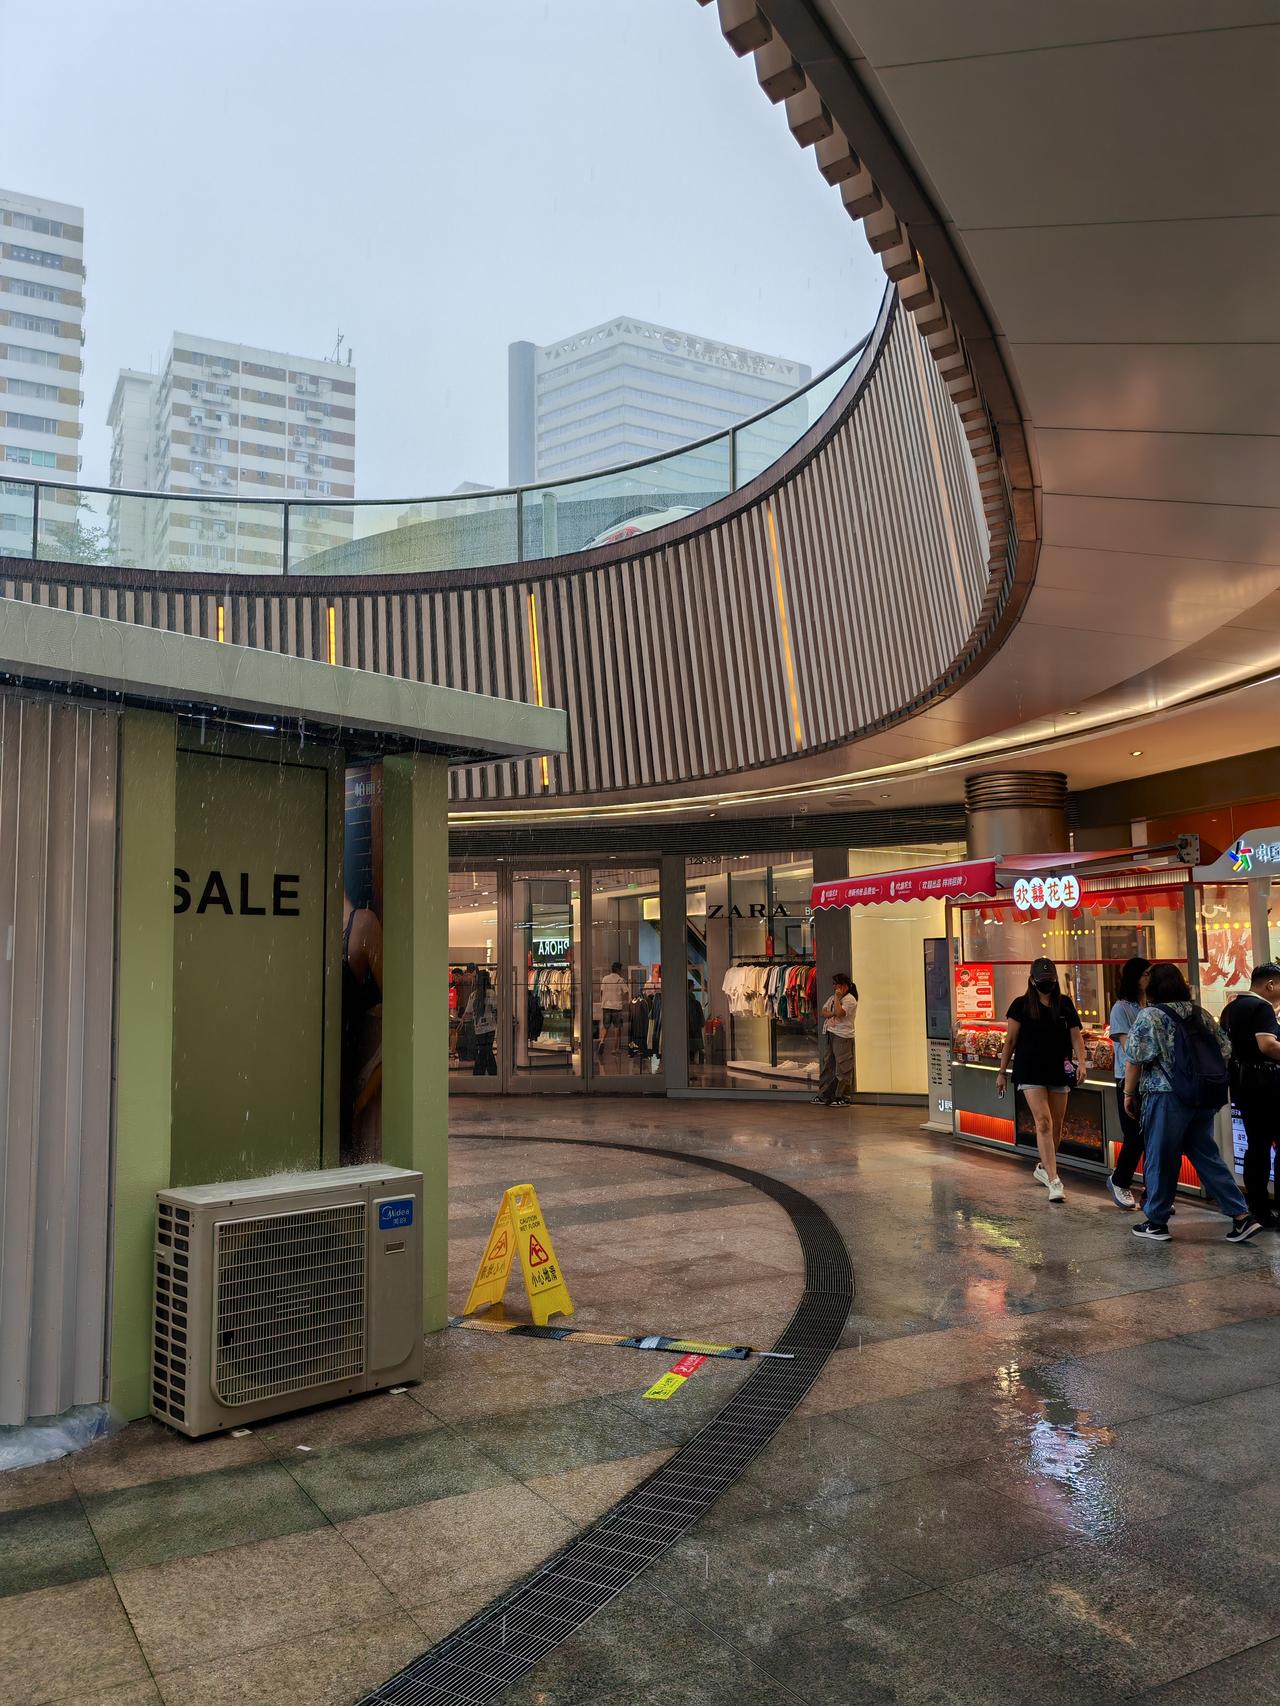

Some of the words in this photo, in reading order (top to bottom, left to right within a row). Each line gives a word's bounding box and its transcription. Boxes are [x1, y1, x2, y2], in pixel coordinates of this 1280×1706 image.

[174, 867, 301, 917] SALE
[708, 903, 790, 919] ZARA
[387, 1208, 410, 1219] Midea
[519, 1215, 538, 1226] CAUTION
[519, 1225, 528, 1233] WET
[528, 1221, 541, 1231] FLOOR
